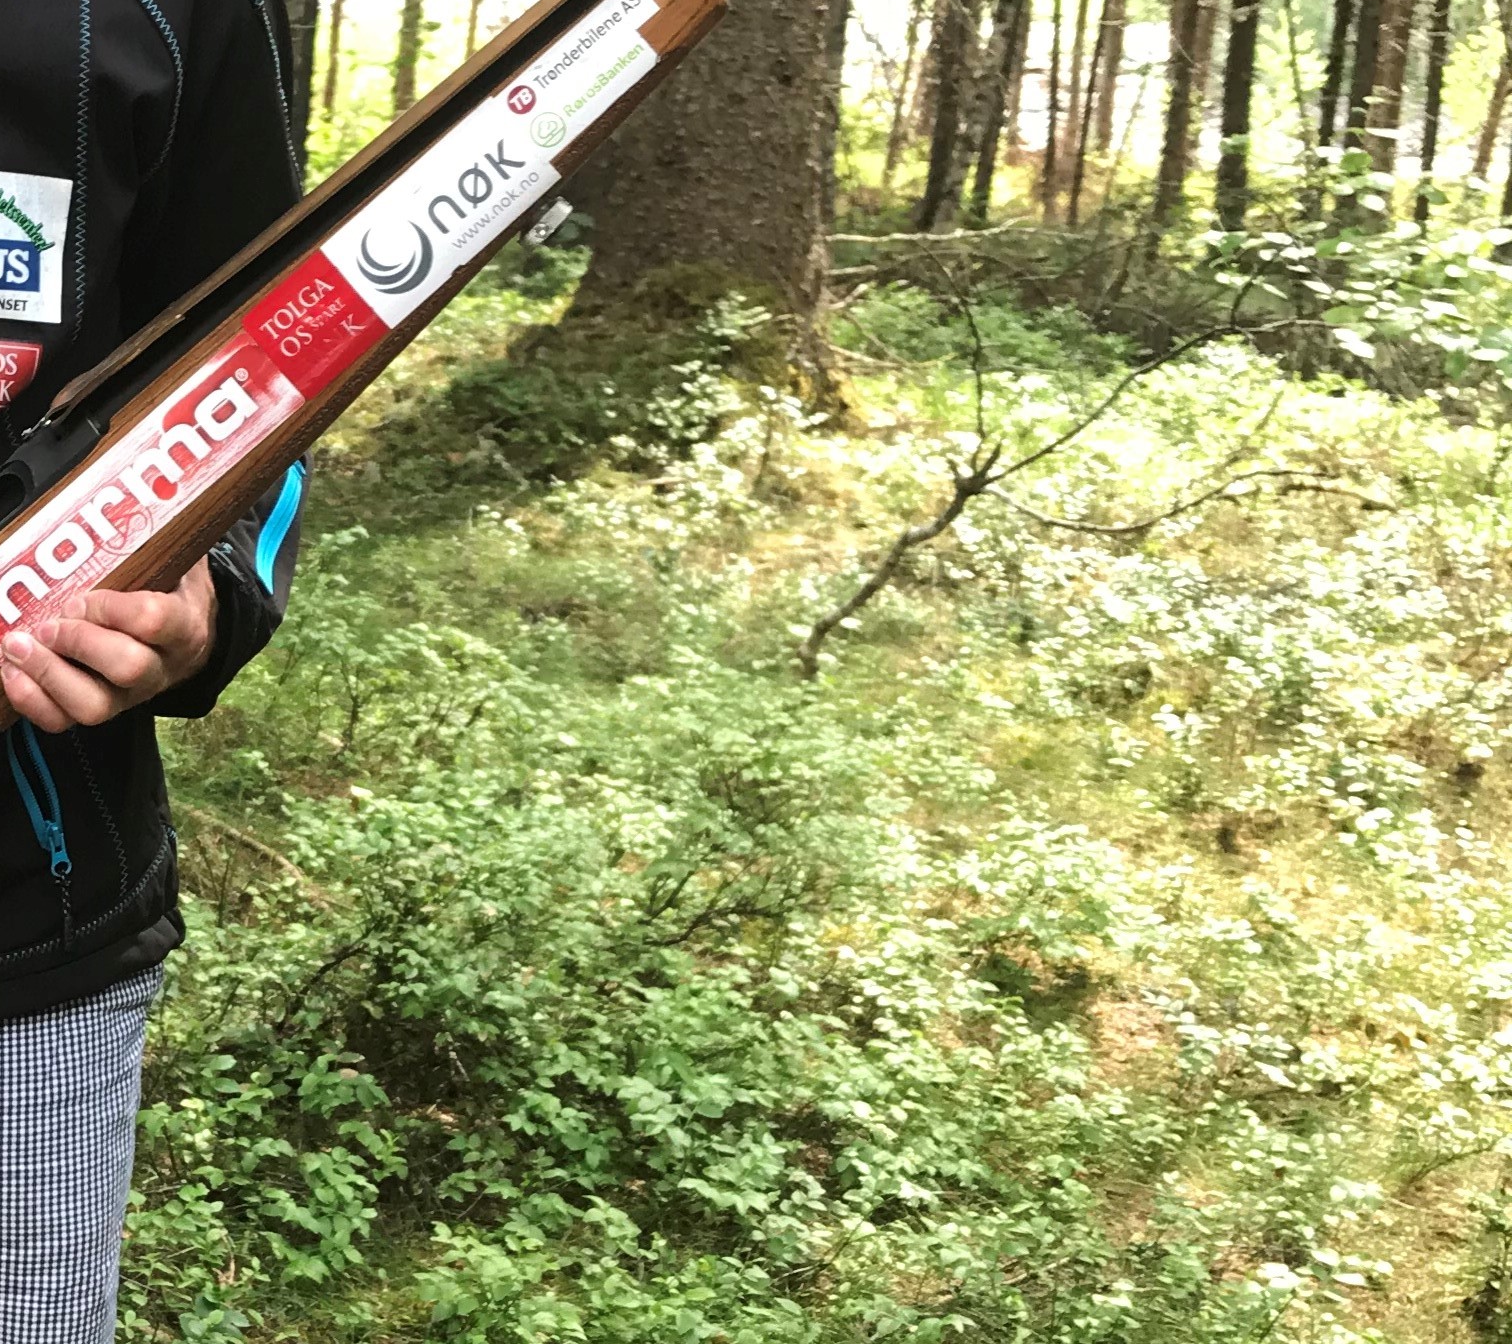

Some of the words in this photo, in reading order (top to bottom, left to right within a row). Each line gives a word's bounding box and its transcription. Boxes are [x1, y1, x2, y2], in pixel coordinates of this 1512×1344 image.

[533, 9, 623, 90] Trønderbilene
[452, 170, 540, 250] www.nok.no
[259, 277, 336, 341] TOLGA
[279, 325, 314, 359] OS
